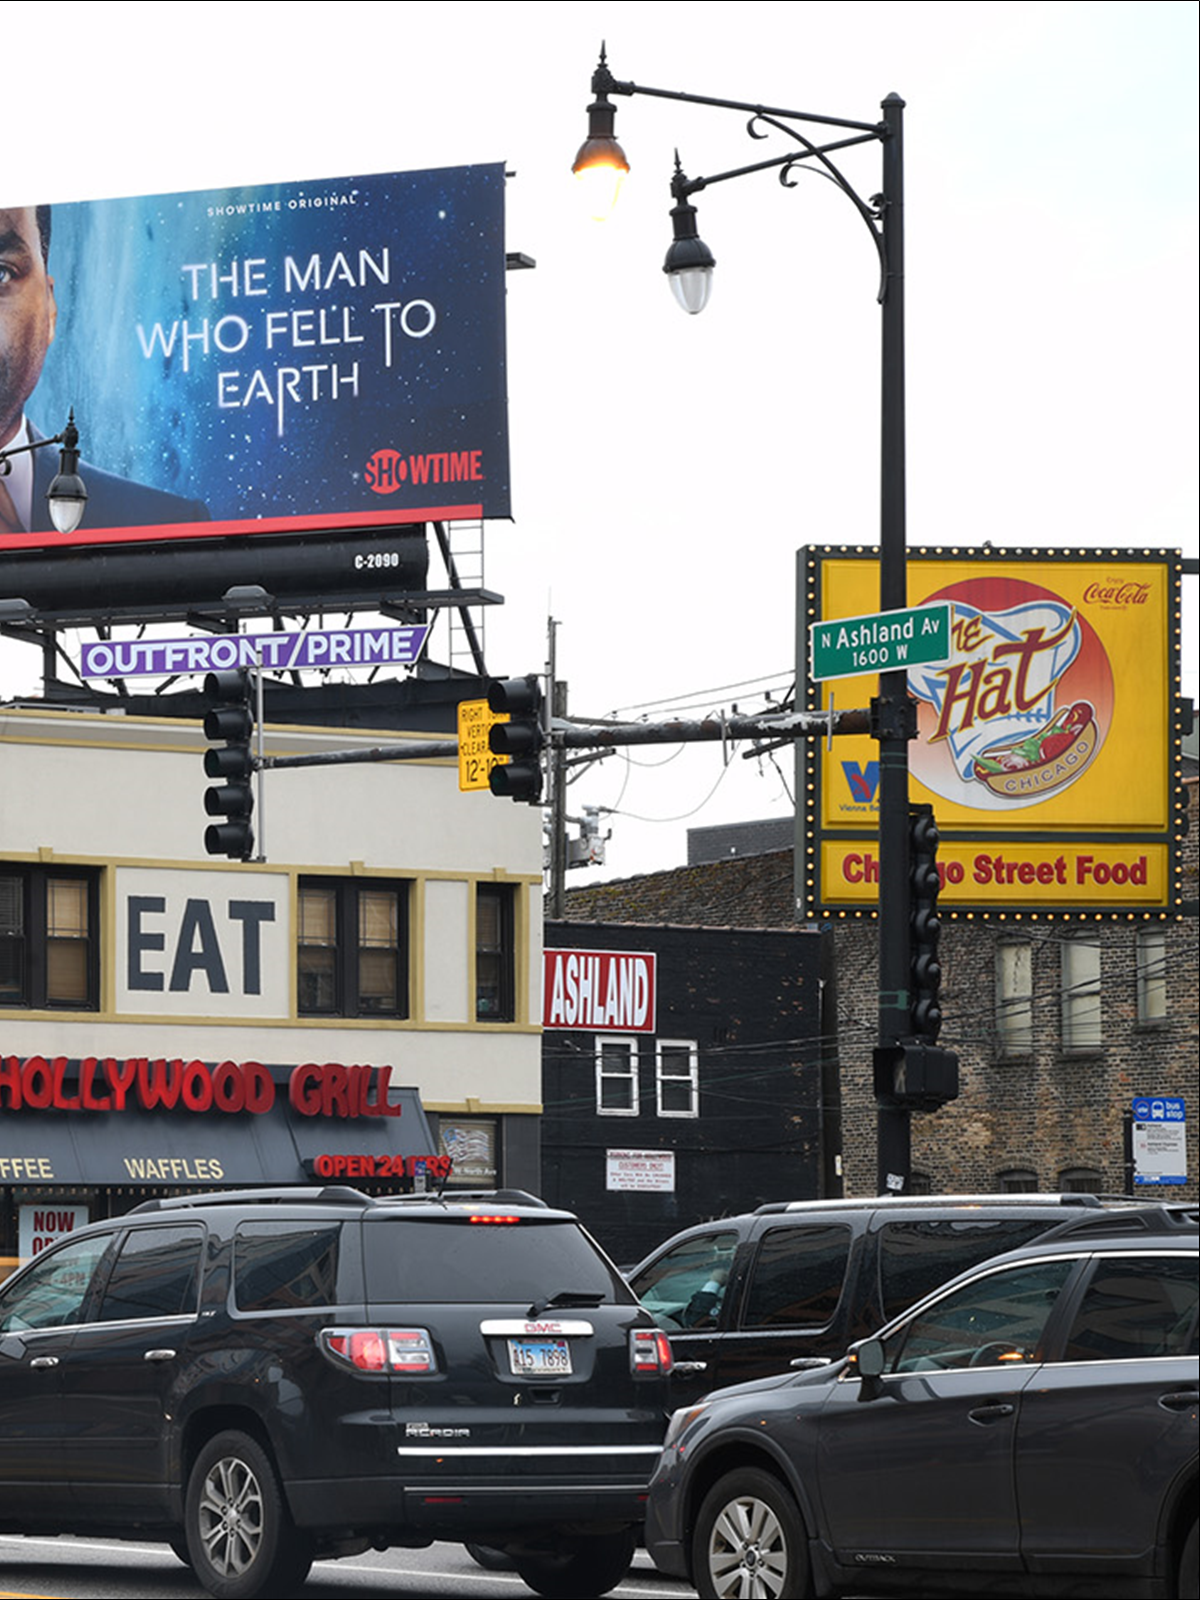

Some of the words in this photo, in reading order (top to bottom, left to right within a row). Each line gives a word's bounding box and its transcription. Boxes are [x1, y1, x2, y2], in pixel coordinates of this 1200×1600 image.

[207, 201, 281, 217] SHOWTIME
[288, 194, 356, 210] ORIGINAL
[182, 258, 267, 300] THE
[284, 248, 389, 293] MAN
[136, 314, 249, 372] WHO
[266, 306, 364, 349] FELL
[374, 299, 436, 367] TO
[218, 362, 359, 437] EARTH
[364, 449, 483, 494] SHOWTIME
[354, 553, 399, 569] C-2090
[821, 632, 831, 649] N
[836, 616, 914, 650] Ashland
[921, 617, 940, 636] Av
[852, 646, 889, 667] 1600
[896, 643, 908, 661] W
[927, 605, 1078, 744] Hat
[1004, 741, 1090, 792] CHICAGO
[973, 854, 1067, 885] Street
[1076, 856, 1147, 886] Food
[127, 895, 275, 995] EAT
[550, 954, 648, 1027] ASHLAND
[289, 1064, 402, 1118] GRILL
[123, 1158, 224, 1179] WAFFLES
[314, 1154, 375, 1178] OPEN
[377, 1154, 405, 1178] 24
[34, 1211, 75, 1232] NOW
[524, 1323, 562, 1333] GMC
[405, 1428, 470, 1437] ACADIA
